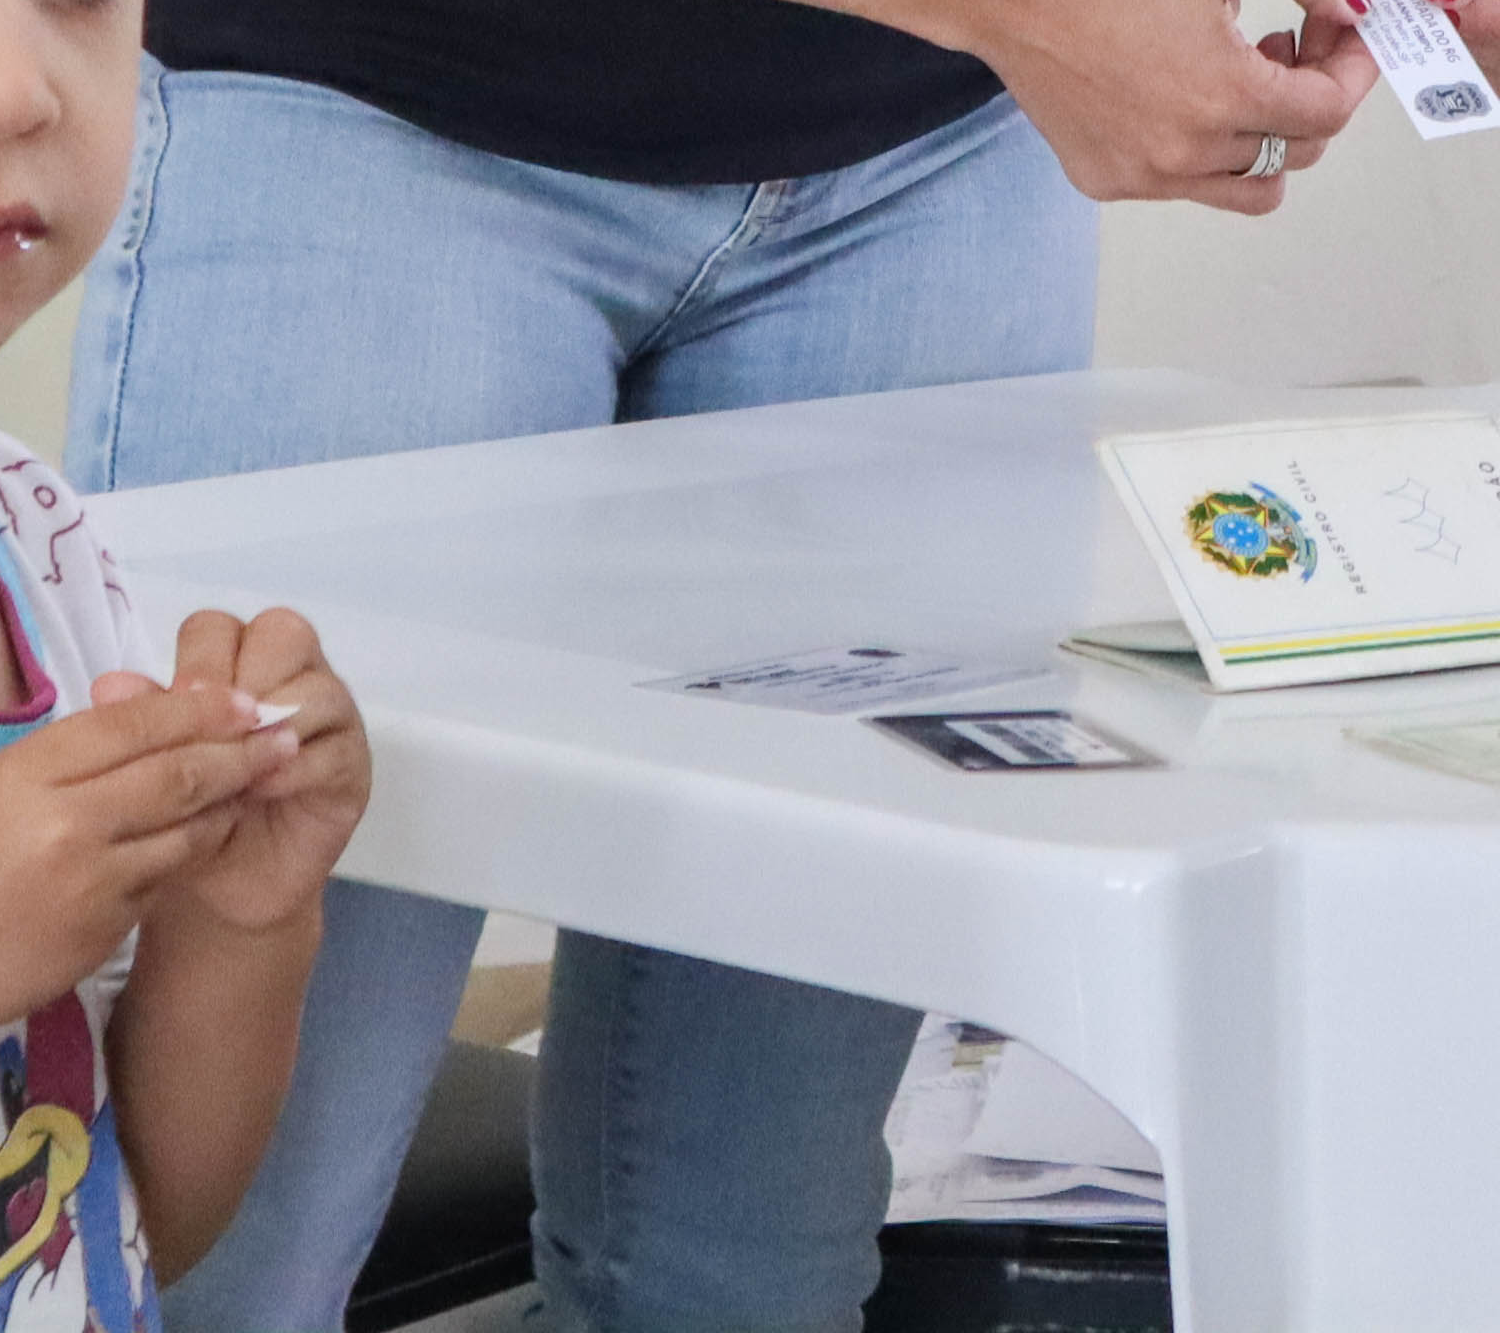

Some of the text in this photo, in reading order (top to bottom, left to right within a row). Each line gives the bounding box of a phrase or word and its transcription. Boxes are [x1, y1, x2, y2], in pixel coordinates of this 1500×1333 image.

[1437, 28, 1450, 45] DO
[1445, 47, 1461, 64] RG
[1287, 460, 1368, 595] REGISTRO CIVIL
